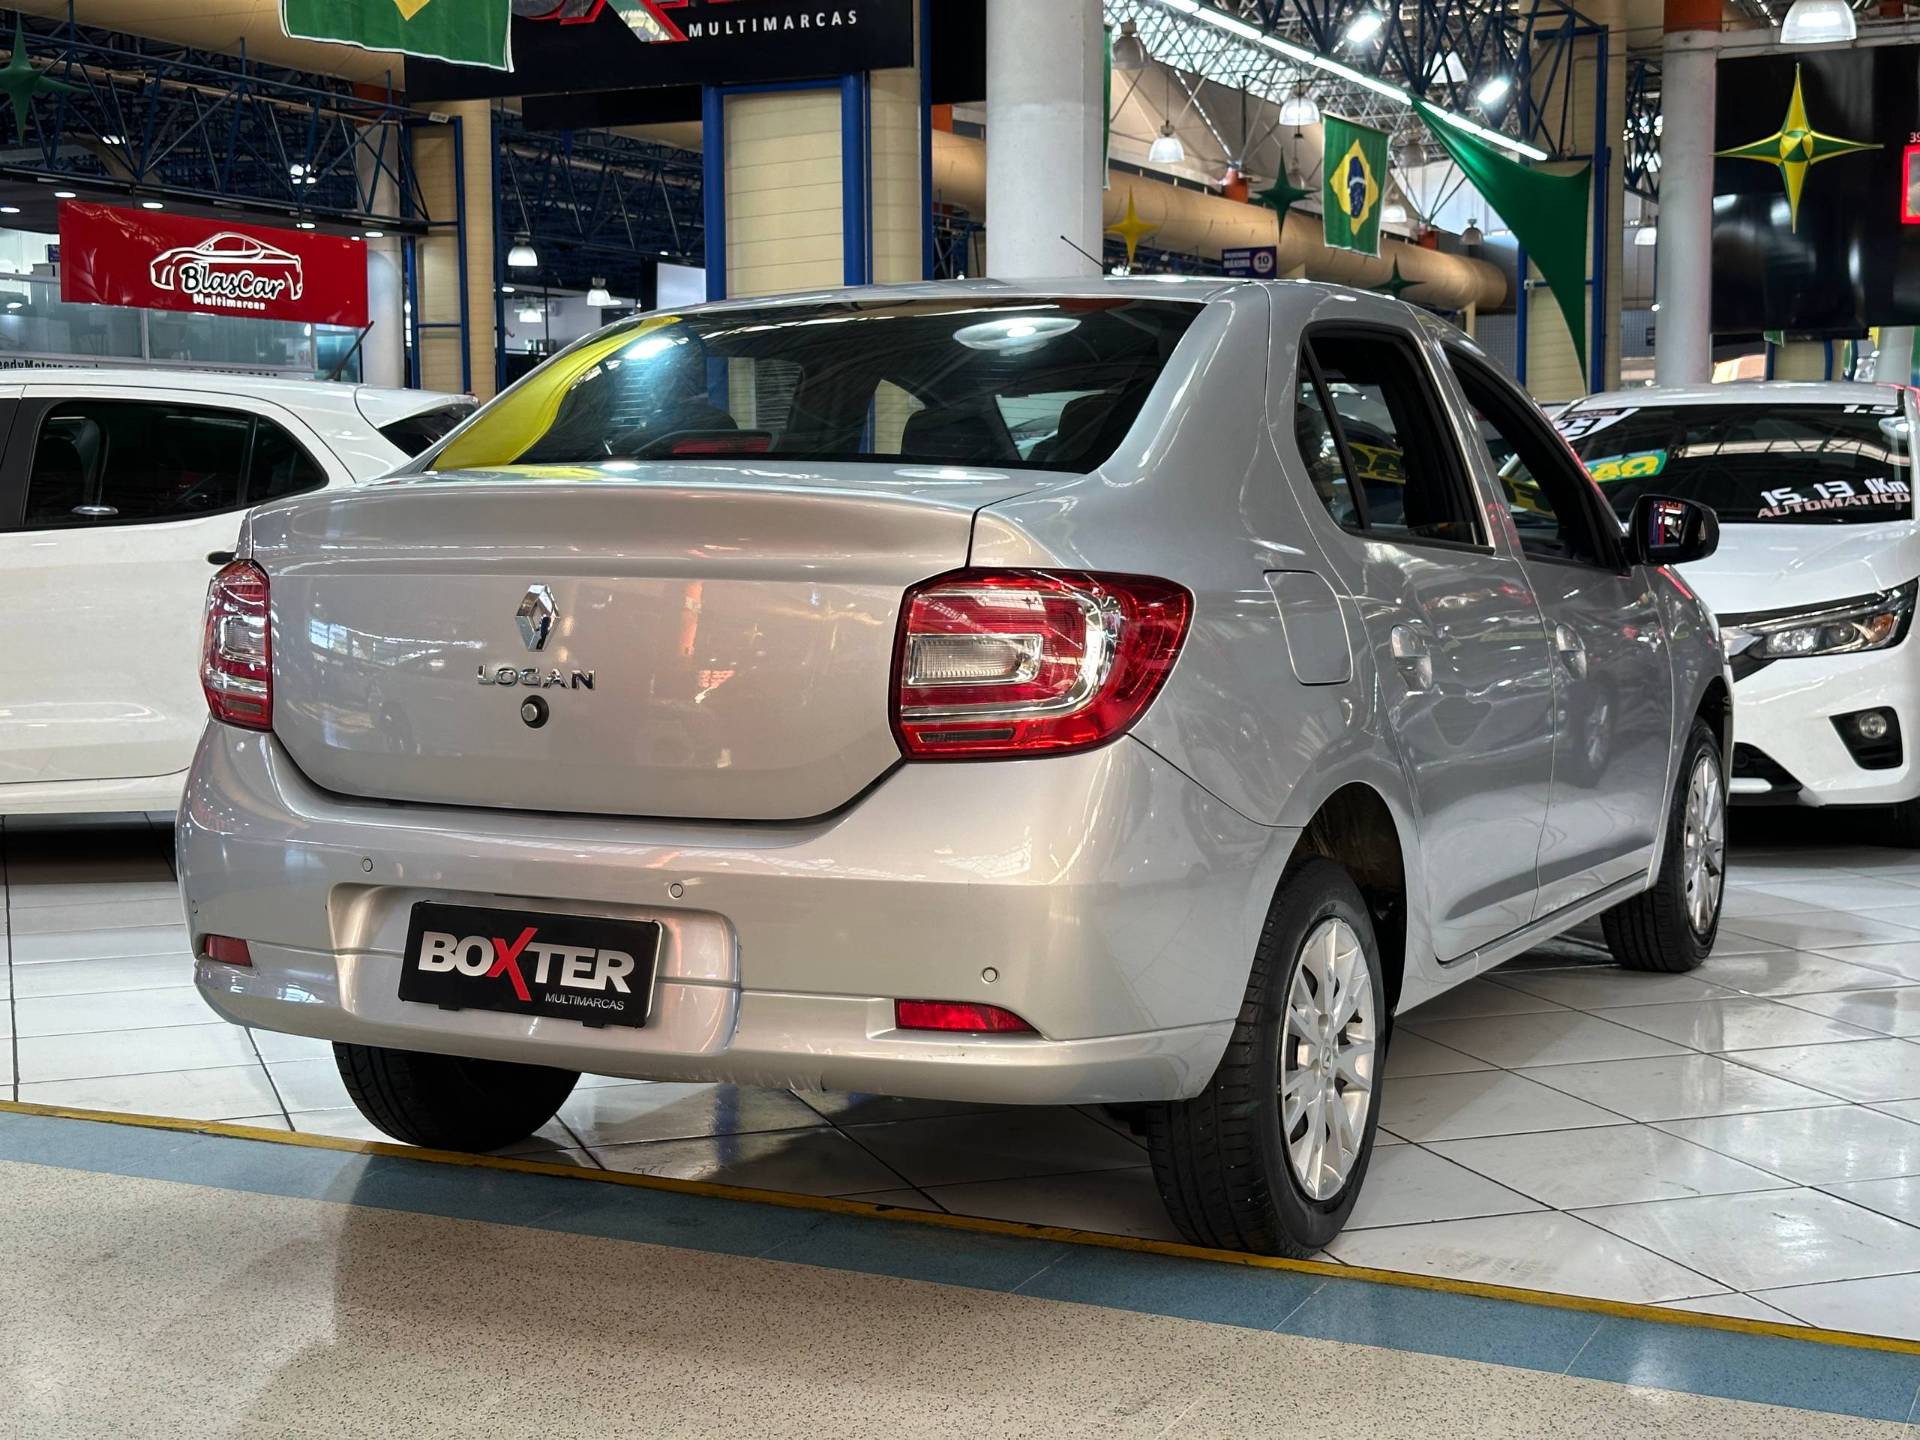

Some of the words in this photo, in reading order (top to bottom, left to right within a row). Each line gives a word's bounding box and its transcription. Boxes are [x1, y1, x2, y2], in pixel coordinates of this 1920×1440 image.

[688, 10, 857, 38] MULTIMARCAS
[179, 262, 285, 300] BlasCar
[193, 293, 266, 311] Multimarcas
[1843, 404, 1898, 415] 1.5
[477, 664, 596, 690] LOGAN
[418, 927, 635, 1002] BOXTER
[545, 992, 625, 1011] MULTIMARCAS
